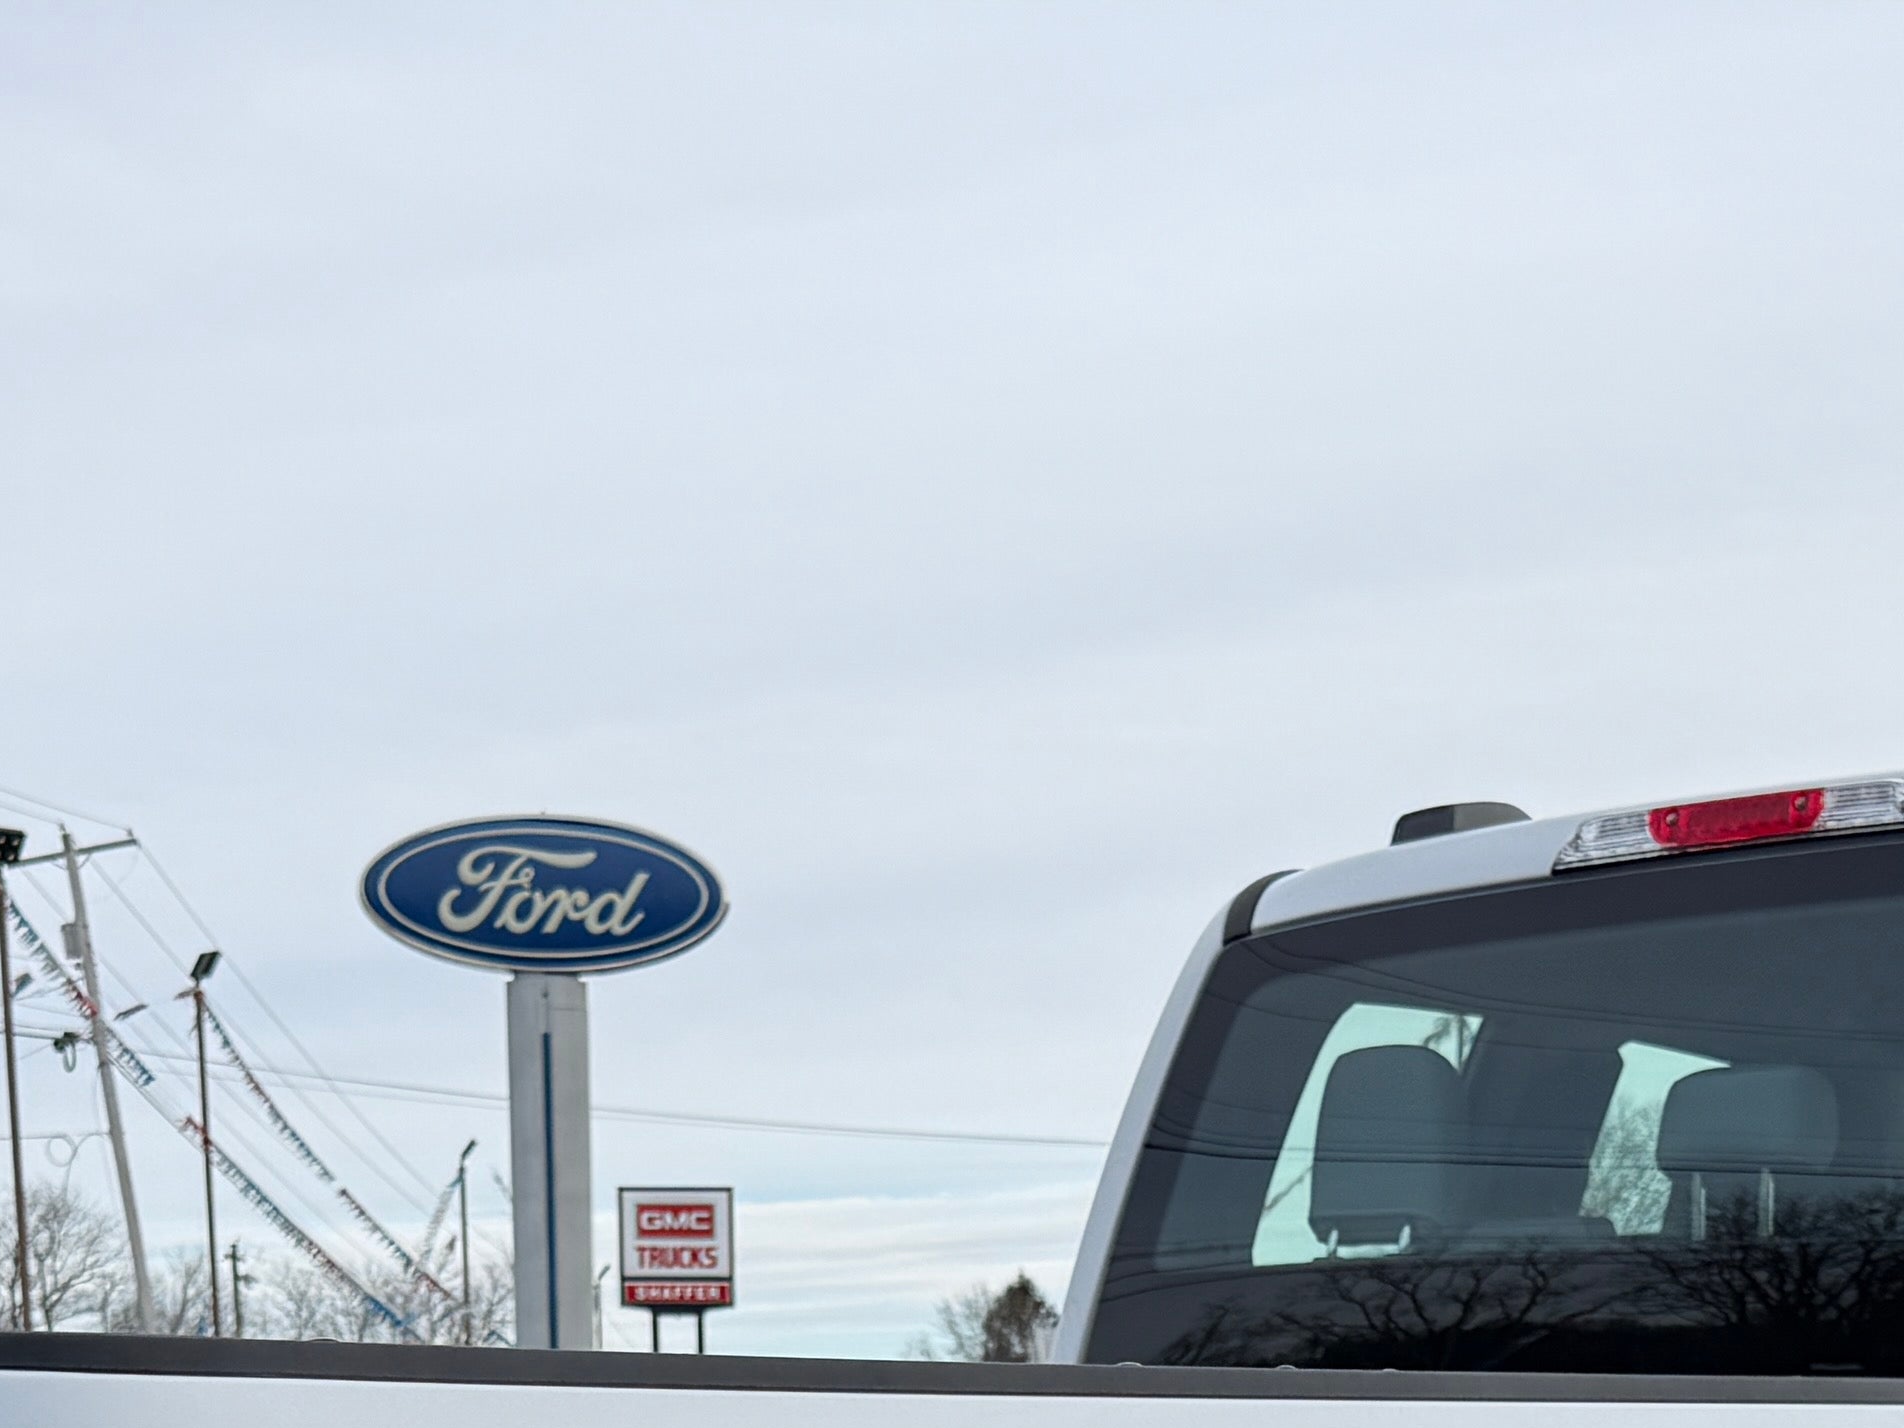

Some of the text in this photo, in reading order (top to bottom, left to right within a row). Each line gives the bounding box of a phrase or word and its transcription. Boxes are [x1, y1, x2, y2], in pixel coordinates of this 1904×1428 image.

[438, 845, 651, 936] Ford
[639, 1210, 711, 1231] GMC
[637, 1246, 718, 1269] TRUCKS
